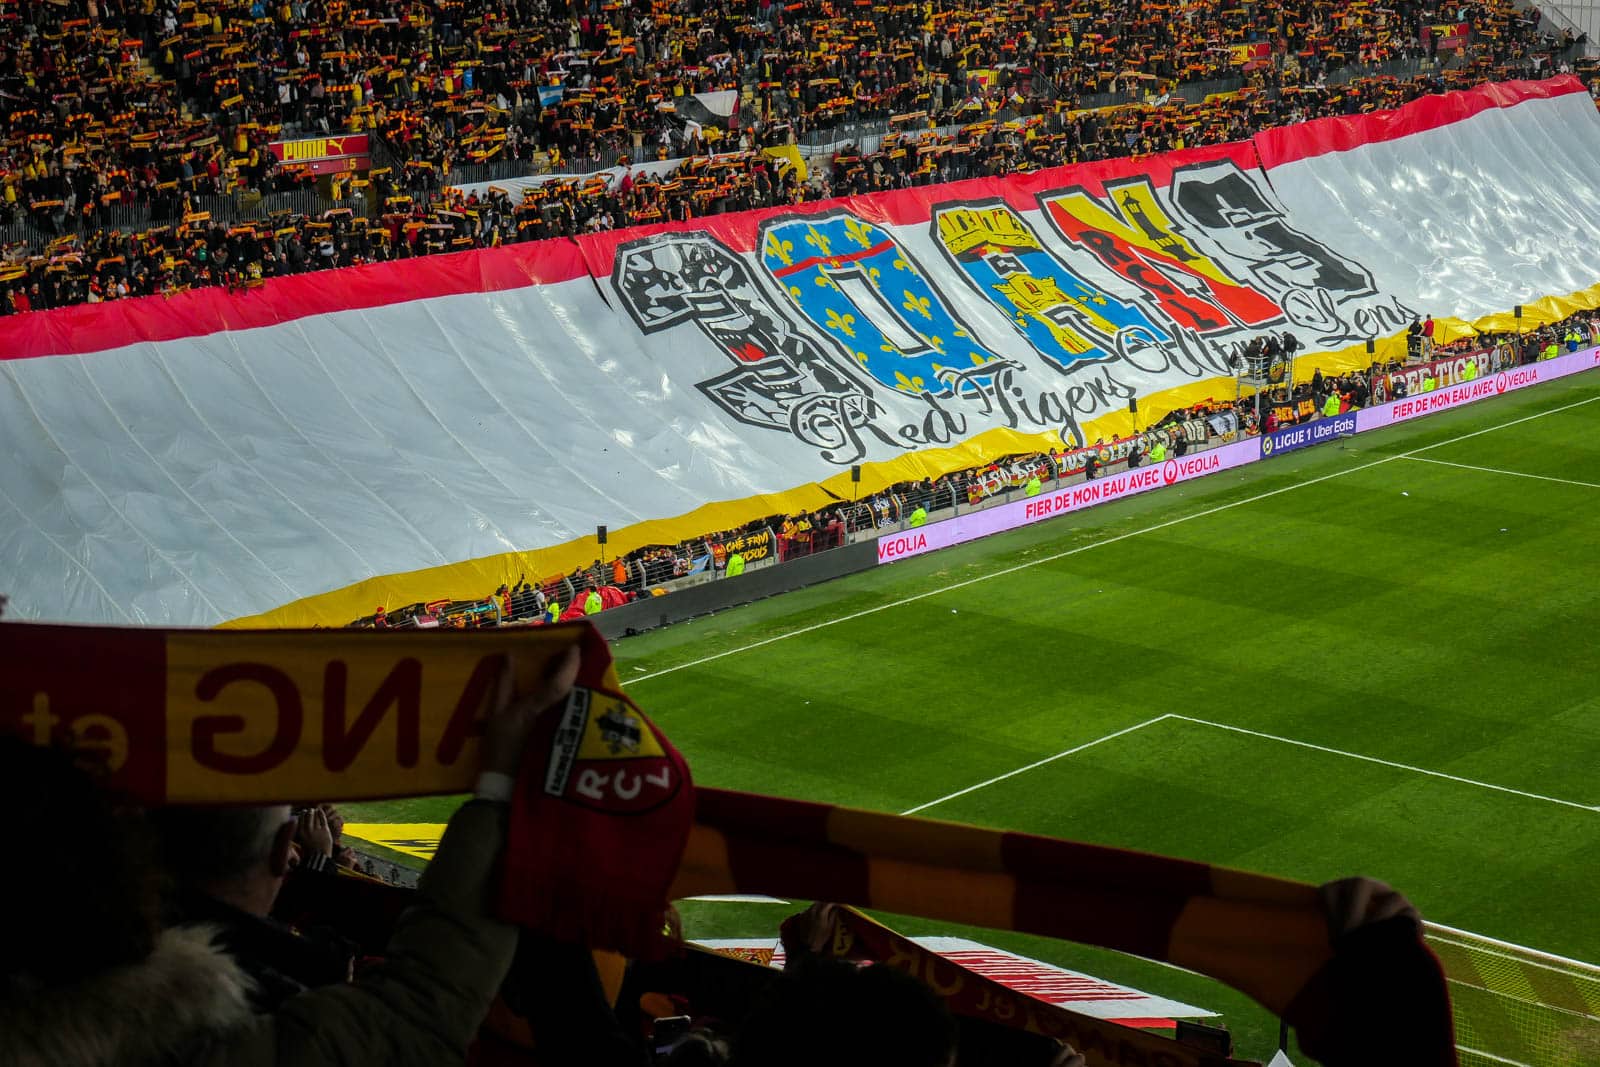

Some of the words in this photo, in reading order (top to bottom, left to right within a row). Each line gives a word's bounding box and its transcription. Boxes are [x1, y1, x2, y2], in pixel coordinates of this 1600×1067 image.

[283, 139, 327, 161] PUMA
[1077, 230, 1220, 329] RCL
[1392, 401, 1413, 420] FIER
[1415, 397, 1429, 413] DE
[1430, 392, 1451, 411] MON
[1452, 386, 1471, 405] EAU
[1472, 379, 1495, 400] AVEC
[1508, 370, 1538, 387] VEOLIA
[1275, 430, 1305, 450] LIGUE
[1306, 428, 1312, 441] 1
[1313, 422, 1333, 438] Uber
[1334, 417, 1354, 433] Eats
[1025, 500, 1051, 520] FIER
[1054, 495, 1070, 514] DE
[1072, 487, 1101, 510] MON
[1103, 480, 1126, 504] EAU
[1129, 469, 1159, 496] AVEC
[1179, 455, 1220, 477] VEOLIA
[878, 533, 927, 559] VEOLIA
[576, 765, 671, 800] RCL
